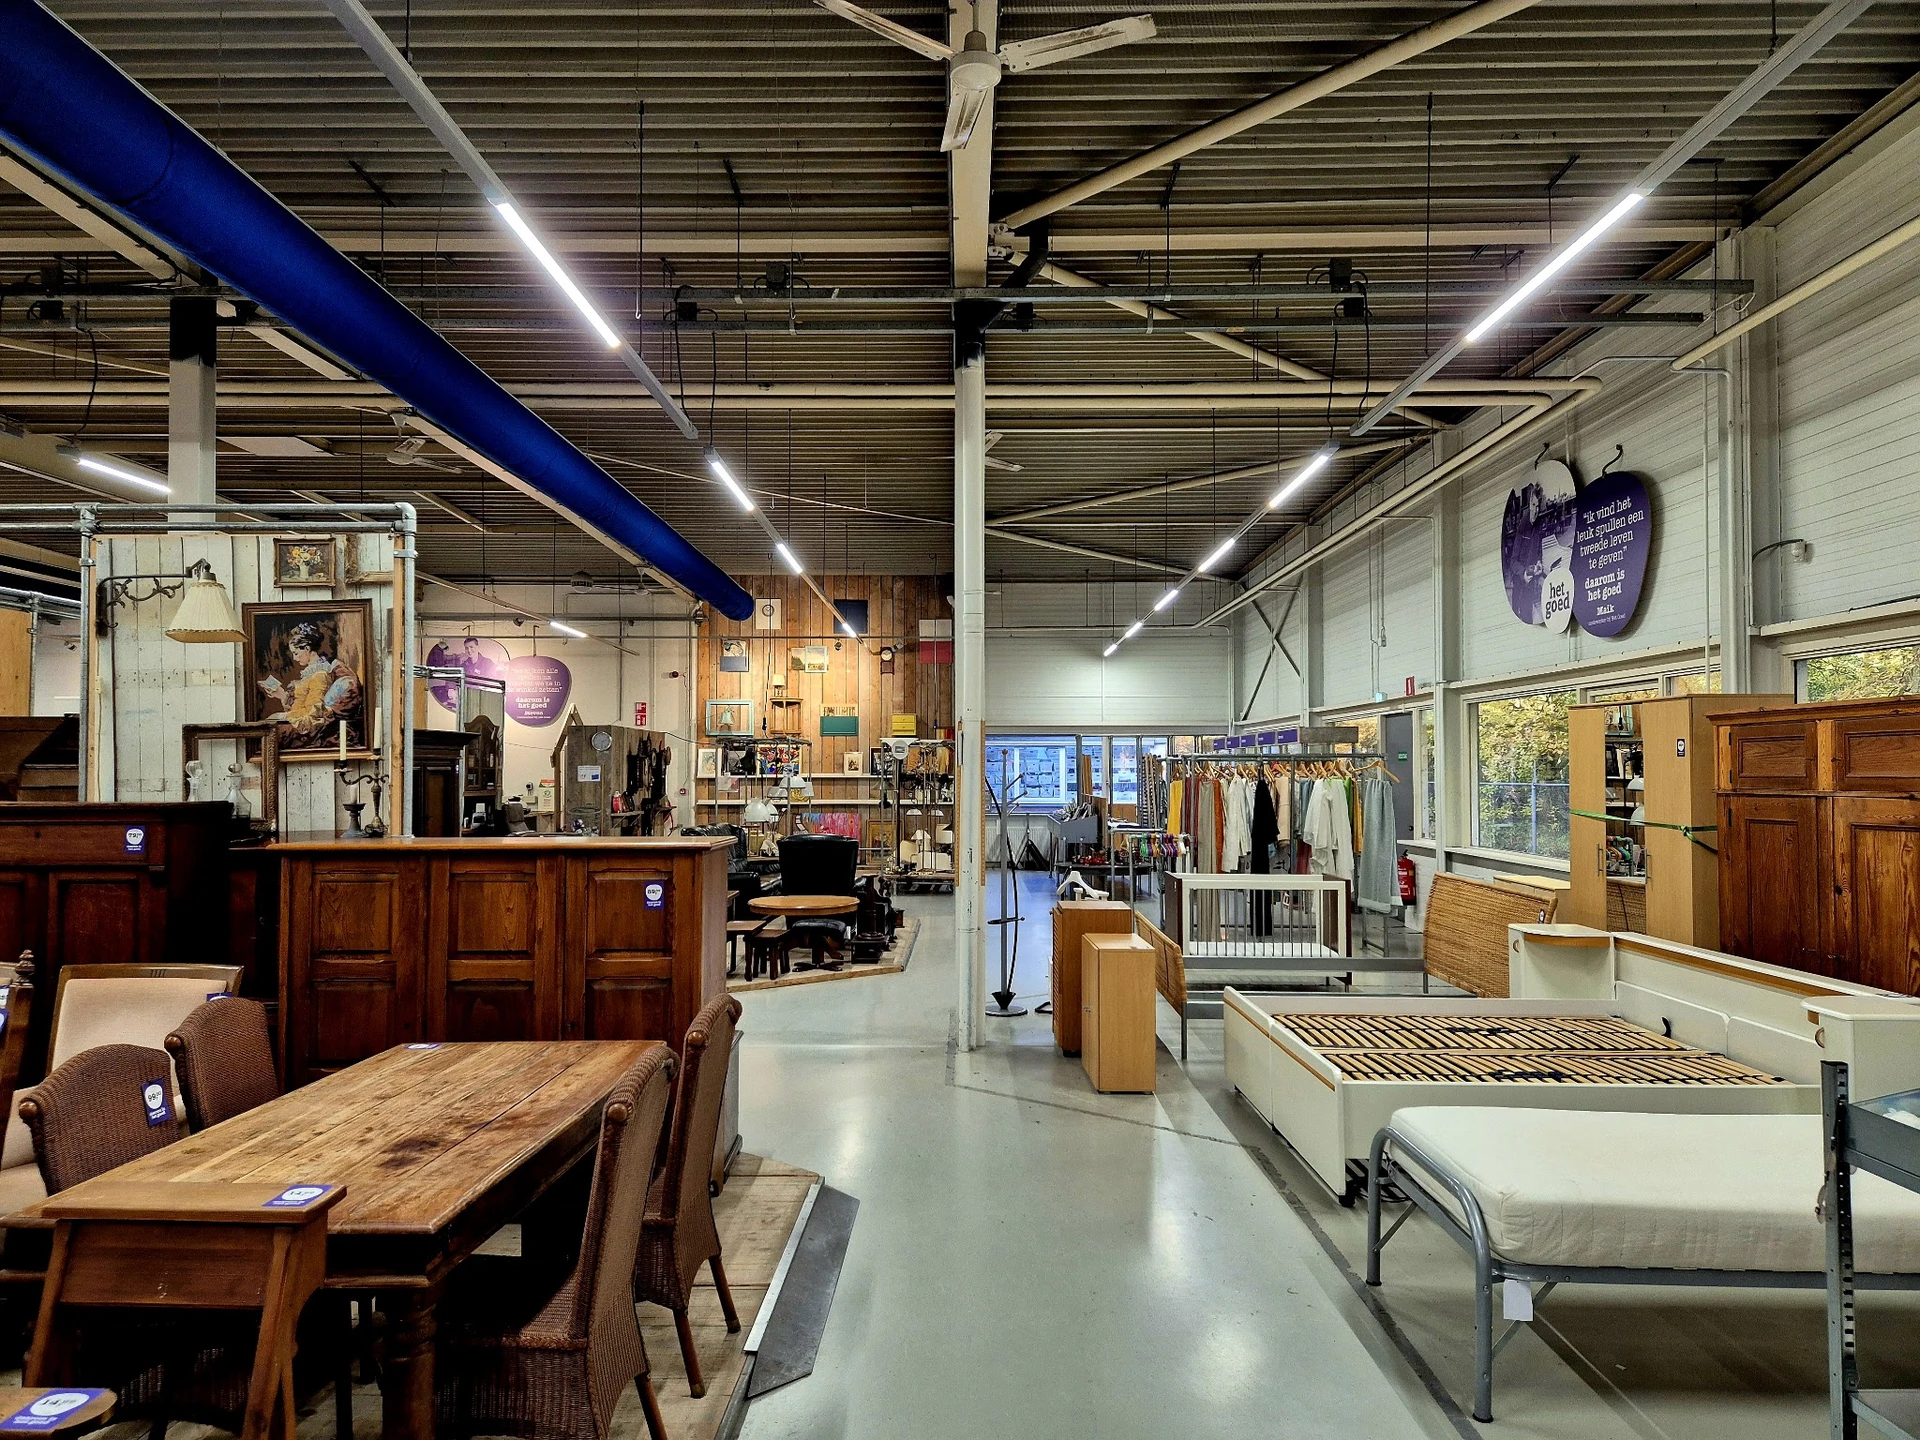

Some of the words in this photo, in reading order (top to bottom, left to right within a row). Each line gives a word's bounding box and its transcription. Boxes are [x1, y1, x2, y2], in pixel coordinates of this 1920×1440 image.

[1596, 502, 1616, 520] vind
[1616, 496, 1632, 513] het
[1576, 526, 1595, 543] leuk
[1595, 516, 1627, 538] spullen
[1627, 510, 1644, 524] een
[1580, 538, 1609, 557] tweede
[1609, 530, 1634, 547] leven
[1588, 557, 1598, 570] te
[1584, 572, 1616, 590] daarom
[1616, 568, 1626, 581] is
[1549, 581, 1566, 600] het
[1587, 587, 1601, 602] het
[1602, 582, 1622, 601] goed
[1545, 591, 1571, 620] goed
[1596, 604, 1615, 616] Maik
[531, 702, 548, 710] goed
